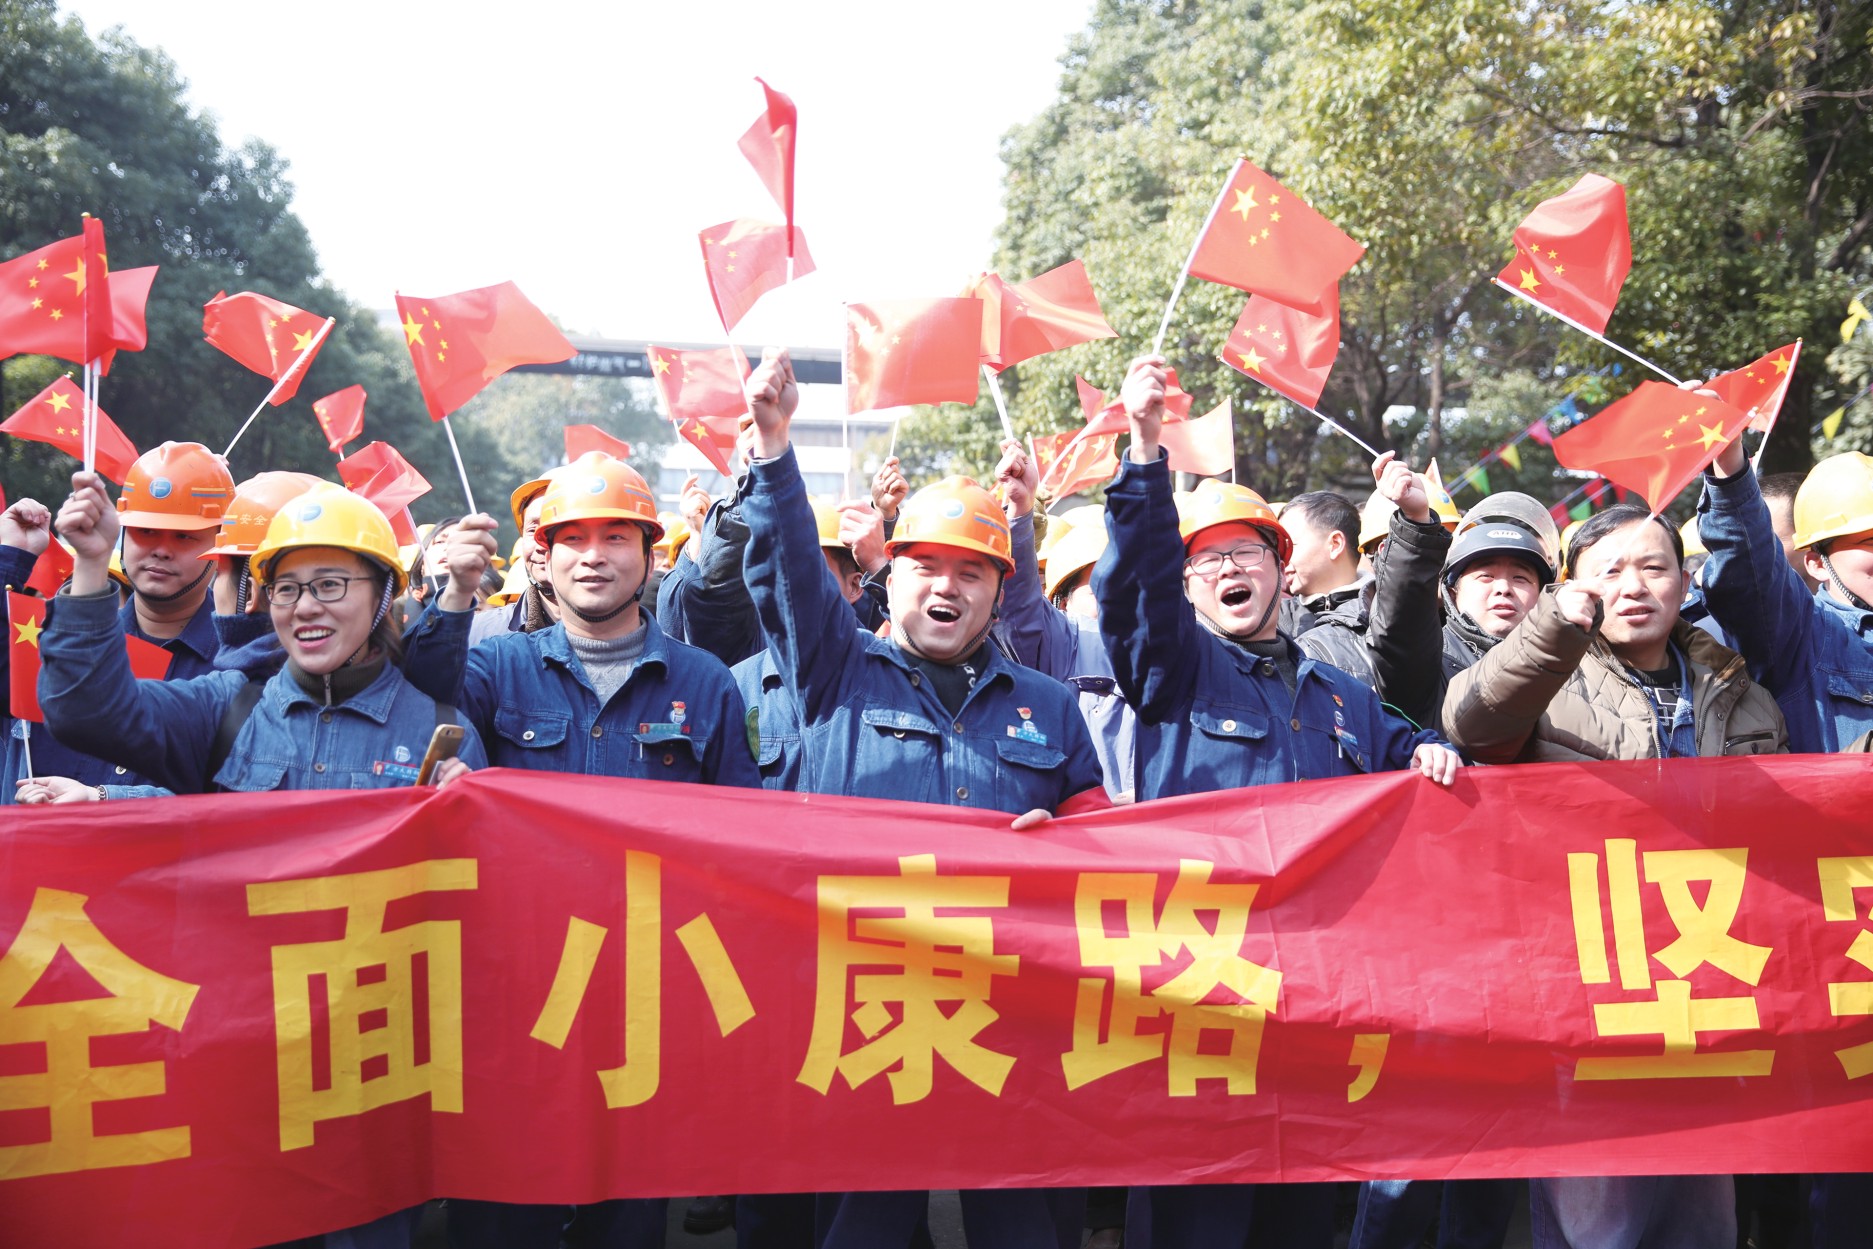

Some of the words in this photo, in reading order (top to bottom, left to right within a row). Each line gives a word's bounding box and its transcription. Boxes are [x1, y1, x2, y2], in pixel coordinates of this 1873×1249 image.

[239, 513, 268, 526] 安全
[0, 838, 1873, 1180] 全面小康路，坚
